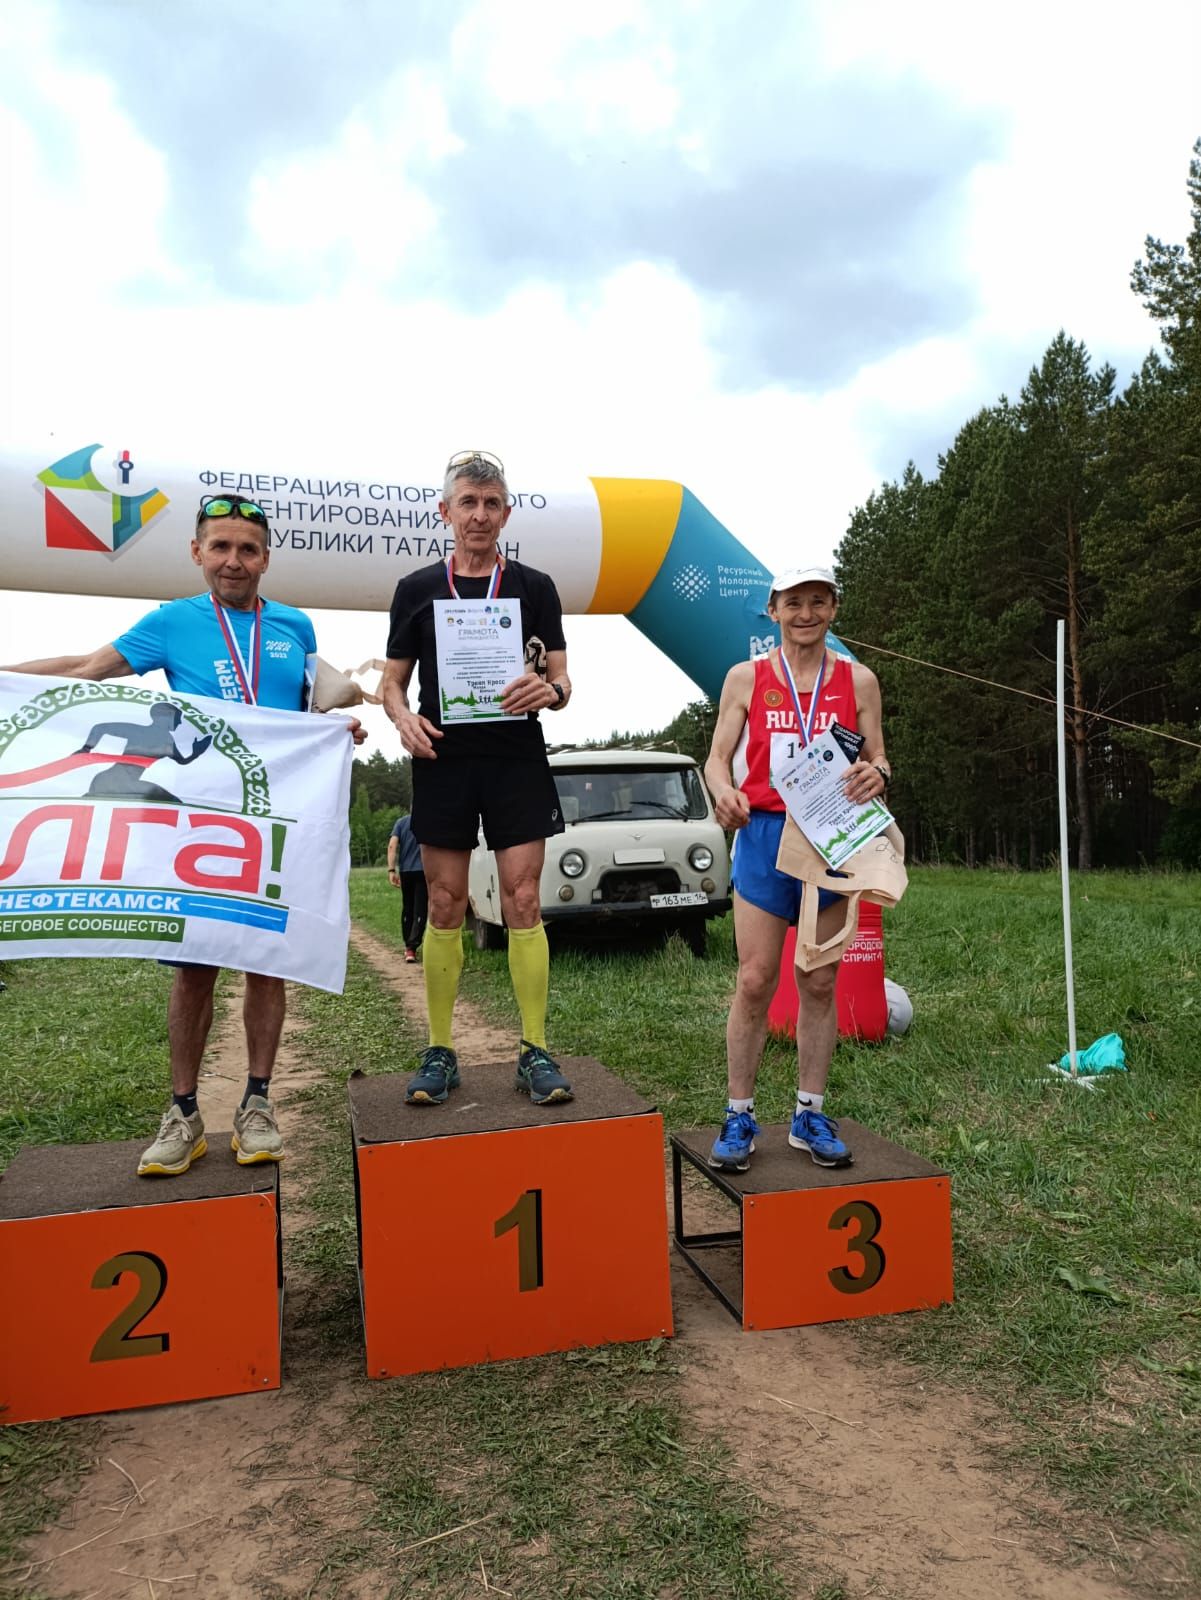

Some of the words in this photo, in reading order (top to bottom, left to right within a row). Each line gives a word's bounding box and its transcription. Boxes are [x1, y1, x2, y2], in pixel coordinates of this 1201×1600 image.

[199, 470, 361, 501] ФЕДЕРАЦИЯ
[718, 577, 772, 587] Молодежны
[719, 587, 749, 598] Центр
[458, 628, 498, 636] ГРАМОТА
[765, 711, 839, 730] RUIA
[799, 766, 829, 791] ГРАМОТА
[0, 892, 181, 912] НЕФТЕКАМСК
[67, 918, 179, 935] СООБЩЕСТВО
[492, 1188, 543, 1293] 1
[827, 1200, 887, 1295] 3
[89, 1250, 171, 1364] 2
